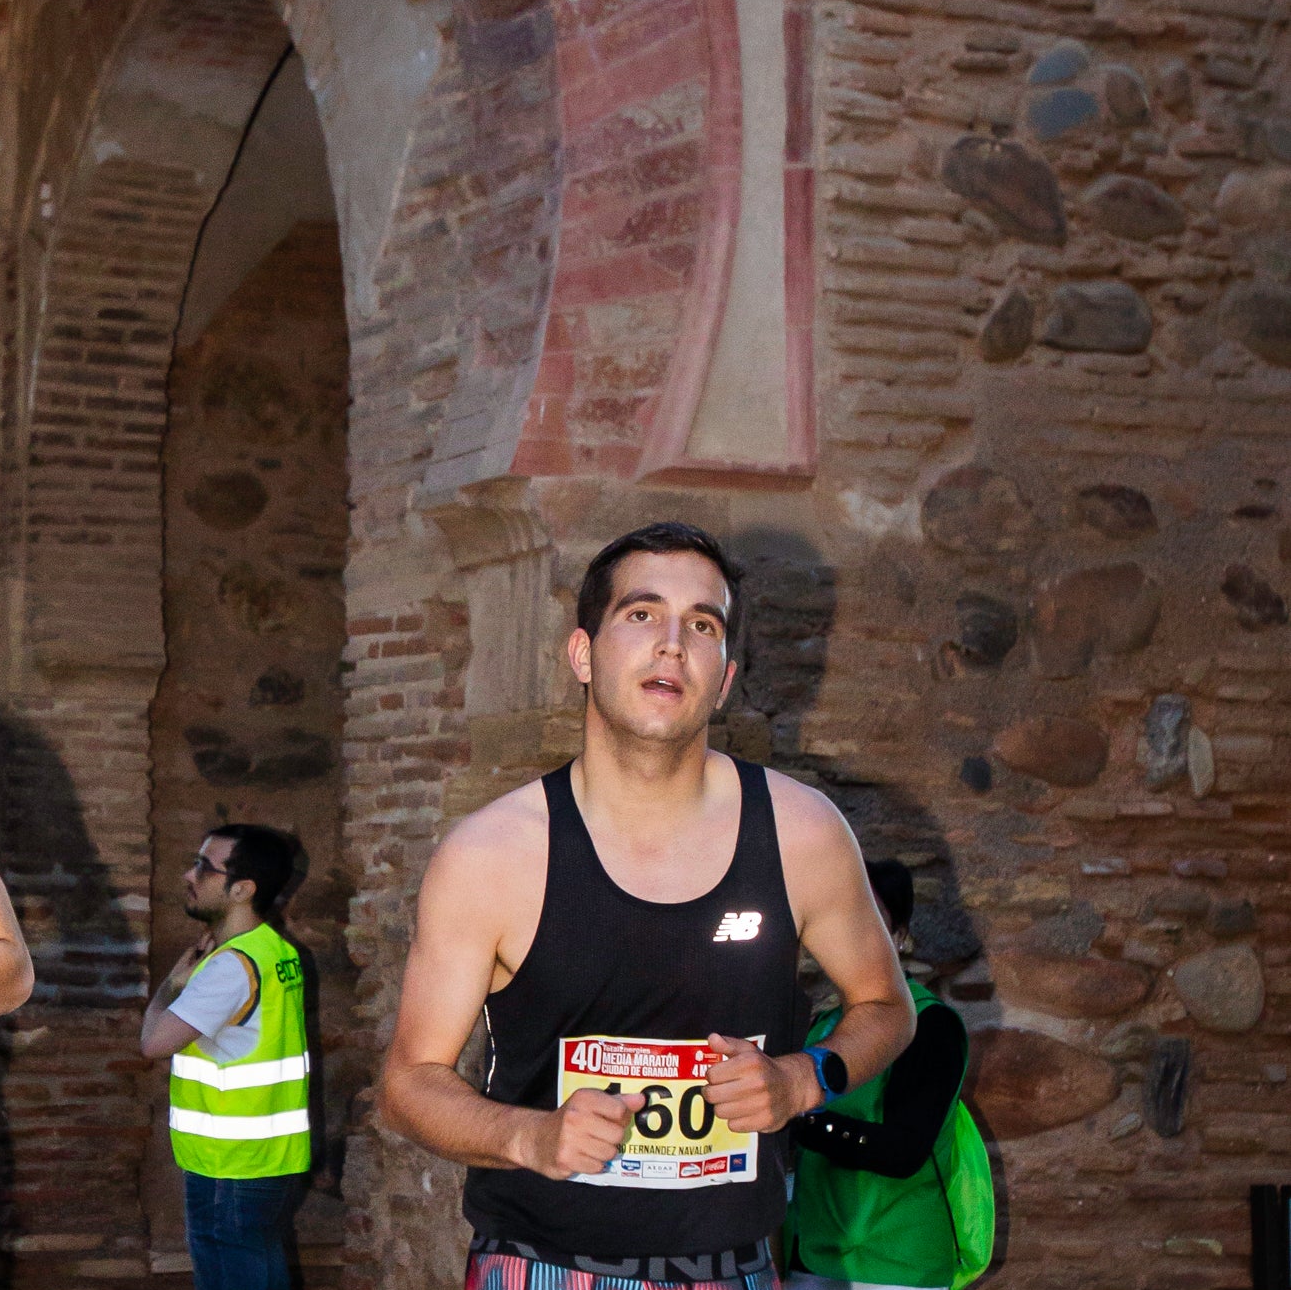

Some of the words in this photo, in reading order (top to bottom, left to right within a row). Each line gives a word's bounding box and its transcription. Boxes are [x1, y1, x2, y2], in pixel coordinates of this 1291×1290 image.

[571, 1042, 602, 1072] 40
[602, 1052, 631, 1066] MEDIA
[633, 1053, 679, 1067] MARATÓN
[601, 1065, 629, 1076] CIUDAD
[631, 1066, 641, 1076] DE
[642, 1067, 678, 1077] GRANADA
[604, 1082, 715, 1140] 60
[628, 1145, 676, 1156] FERNANDEZ
[678, 1144, 713, 1156] NAVALON
